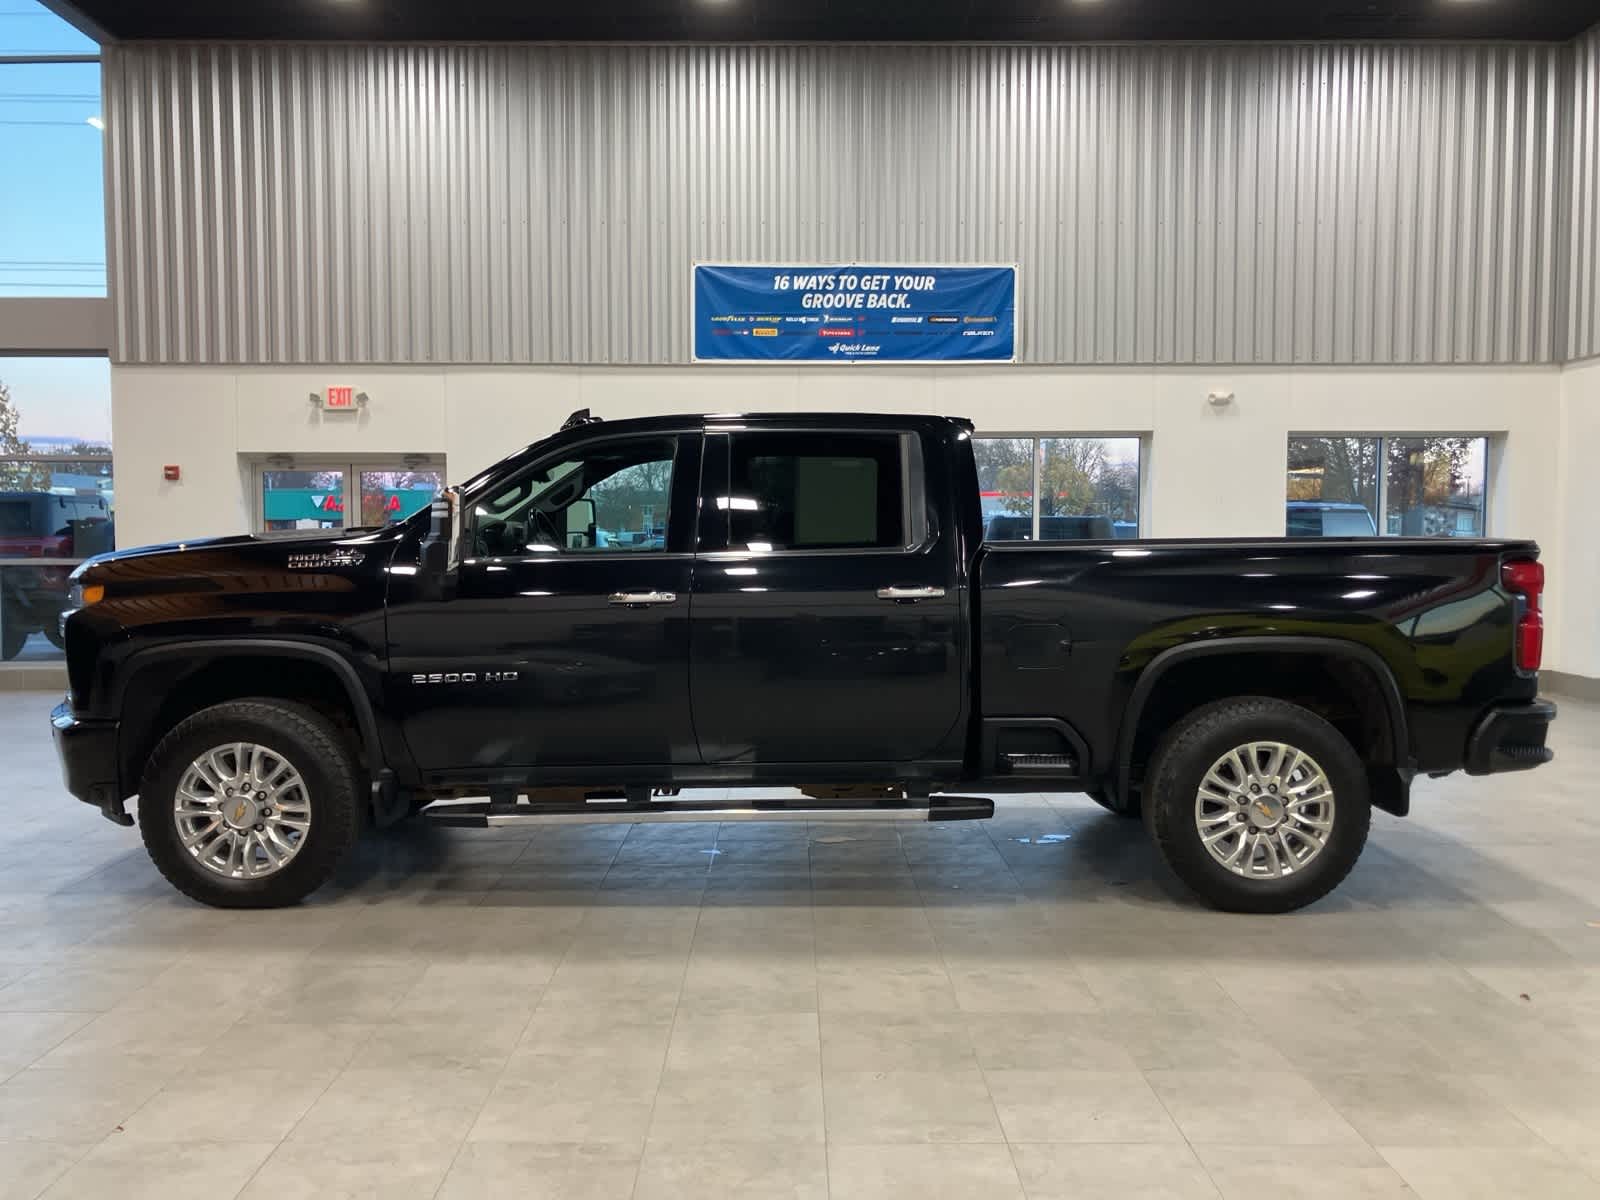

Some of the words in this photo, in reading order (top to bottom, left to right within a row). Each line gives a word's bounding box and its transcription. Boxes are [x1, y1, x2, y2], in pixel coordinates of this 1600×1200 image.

[774, 275, 789, 290] 16
[793, 275, 835, 290] WAYS
[838, 275, 857, 290] TO
[860, 275, 891, 290] GET
[894, 276, 936, 290] YOUR
[802, 293, 865, 309] GROOVE
[867, 293, 911, 309] BACK.
[840, 343, 861, 352] Quick
[861, 343, 881, 352] Lane
[328, 387, 353, 407] EXIT
[412, 673, 477, 684] 2500
[485, 672, 518, 681] HD
